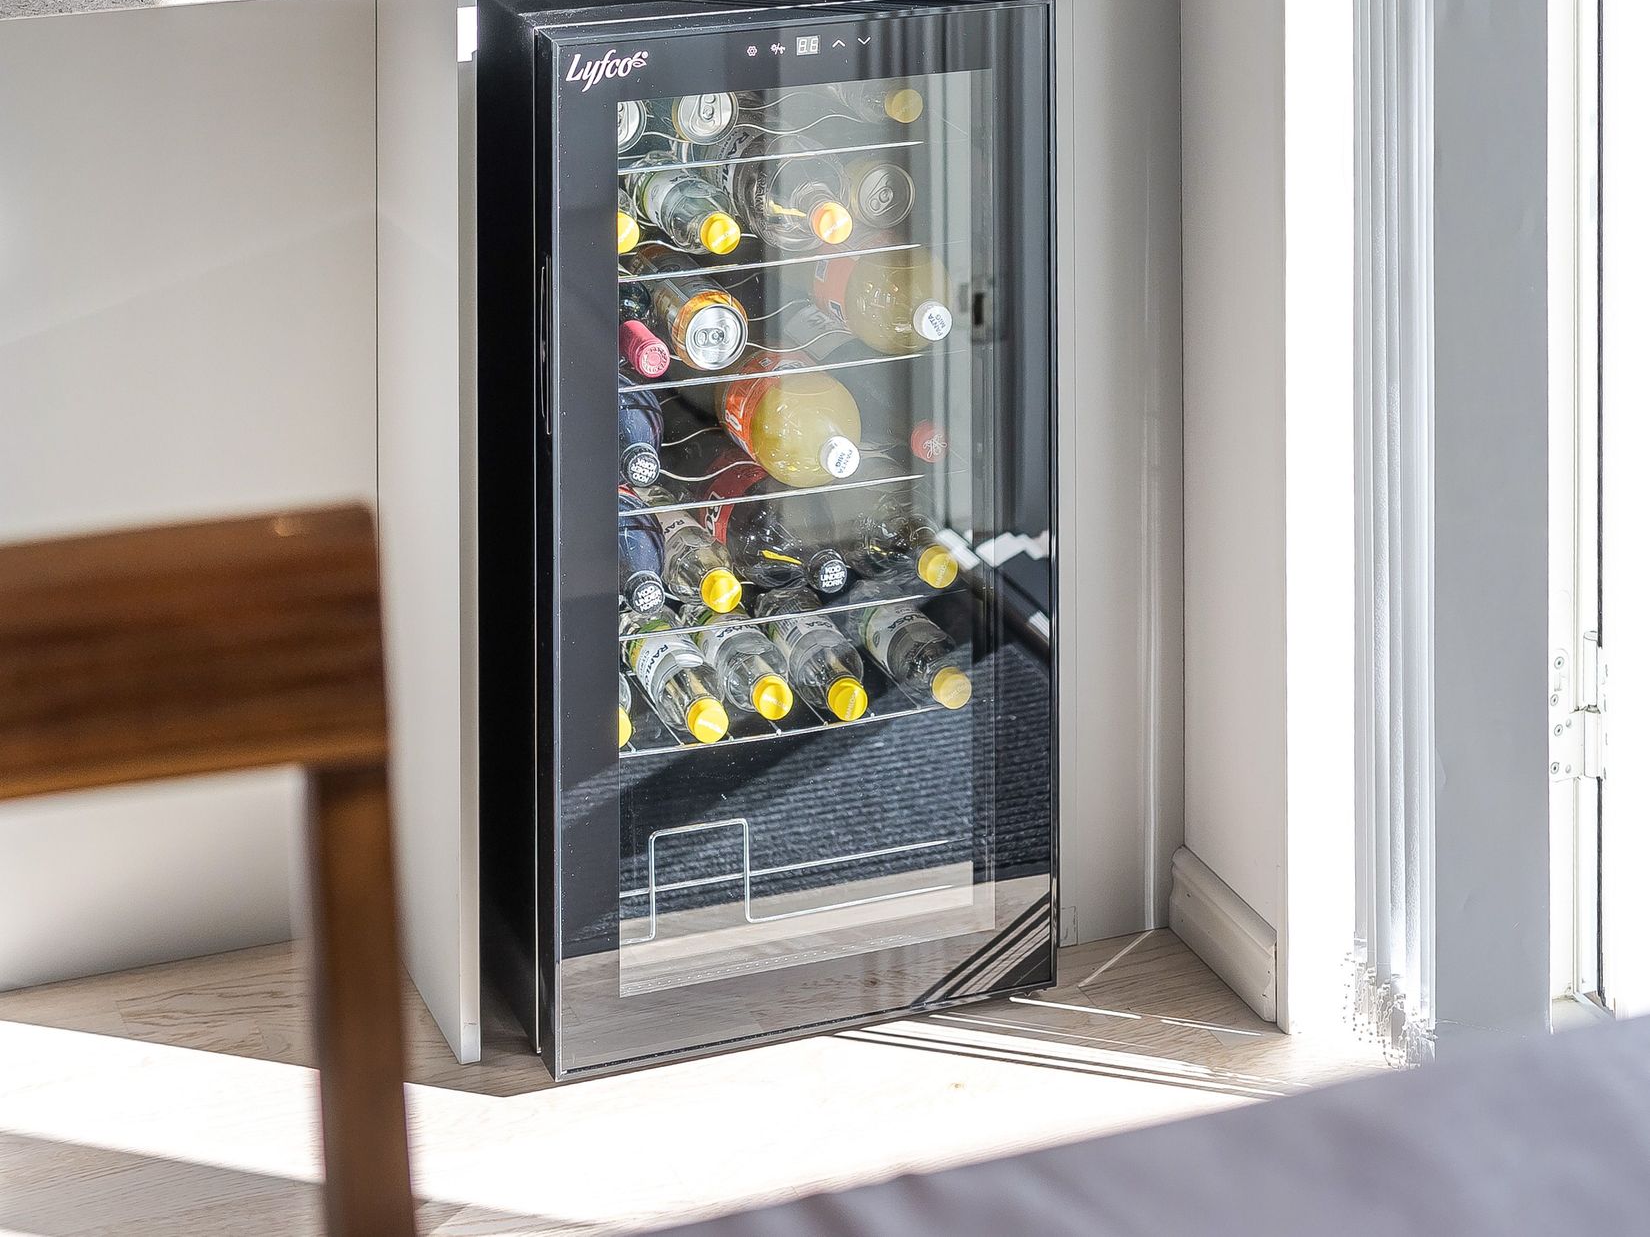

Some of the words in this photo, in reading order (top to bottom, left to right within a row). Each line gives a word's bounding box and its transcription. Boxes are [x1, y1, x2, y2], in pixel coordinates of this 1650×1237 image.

[565, 48, 636, 93] Lyfco
[630, 463, 657, 478] UNDER
[636, 457, 658, 471] KORK
[632, 470, 651, 483] KOD
[820, 571, 845, 581] UNDER
[824, 565, 841, 574] KOD
[822, 578, 844, 588] KORK
[637, 585, 655, 597] KOD
[635, 590, 662, 606] UNDER
[639, 597, 662, 612] KORK
